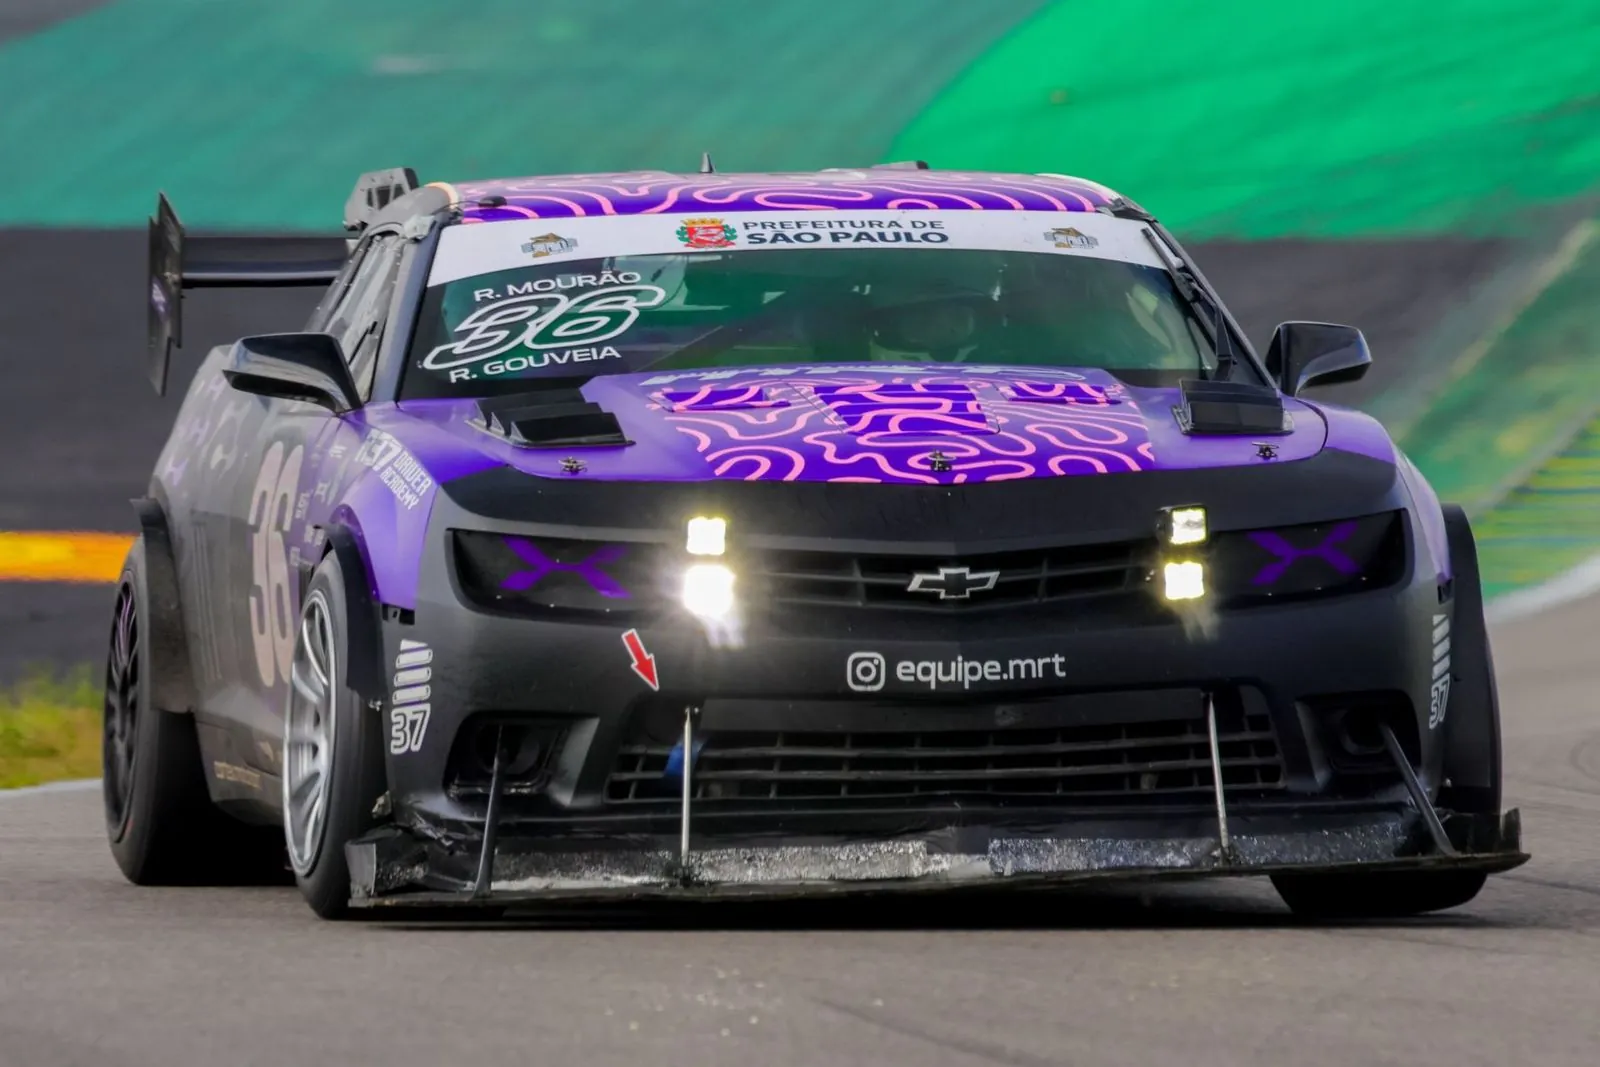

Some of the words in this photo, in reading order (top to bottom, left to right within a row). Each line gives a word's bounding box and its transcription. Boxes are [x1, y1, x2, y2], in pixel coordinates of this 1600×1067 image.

[743, 219, 902, 230] PREFEITURA
[911, 220, 945, 230] DE
[746, 229, 822, 244] SÃO
[831, 231, 949, 244] PAULO
[473, 287, 502, 302] R.
[507, 270, 642, 297] MOURÃO
[449, 367, 478, 384] R.
[484, 345, 622, 376] GOUVEIA
[380, 466, 420, 510] ACADEMY
[393, 449, 432, 497] DRIVER
[248, 440, 303, 683] 36
[896, 653, 1067, 690] equipe.mrt
[390, 702, 431, 755] 37
